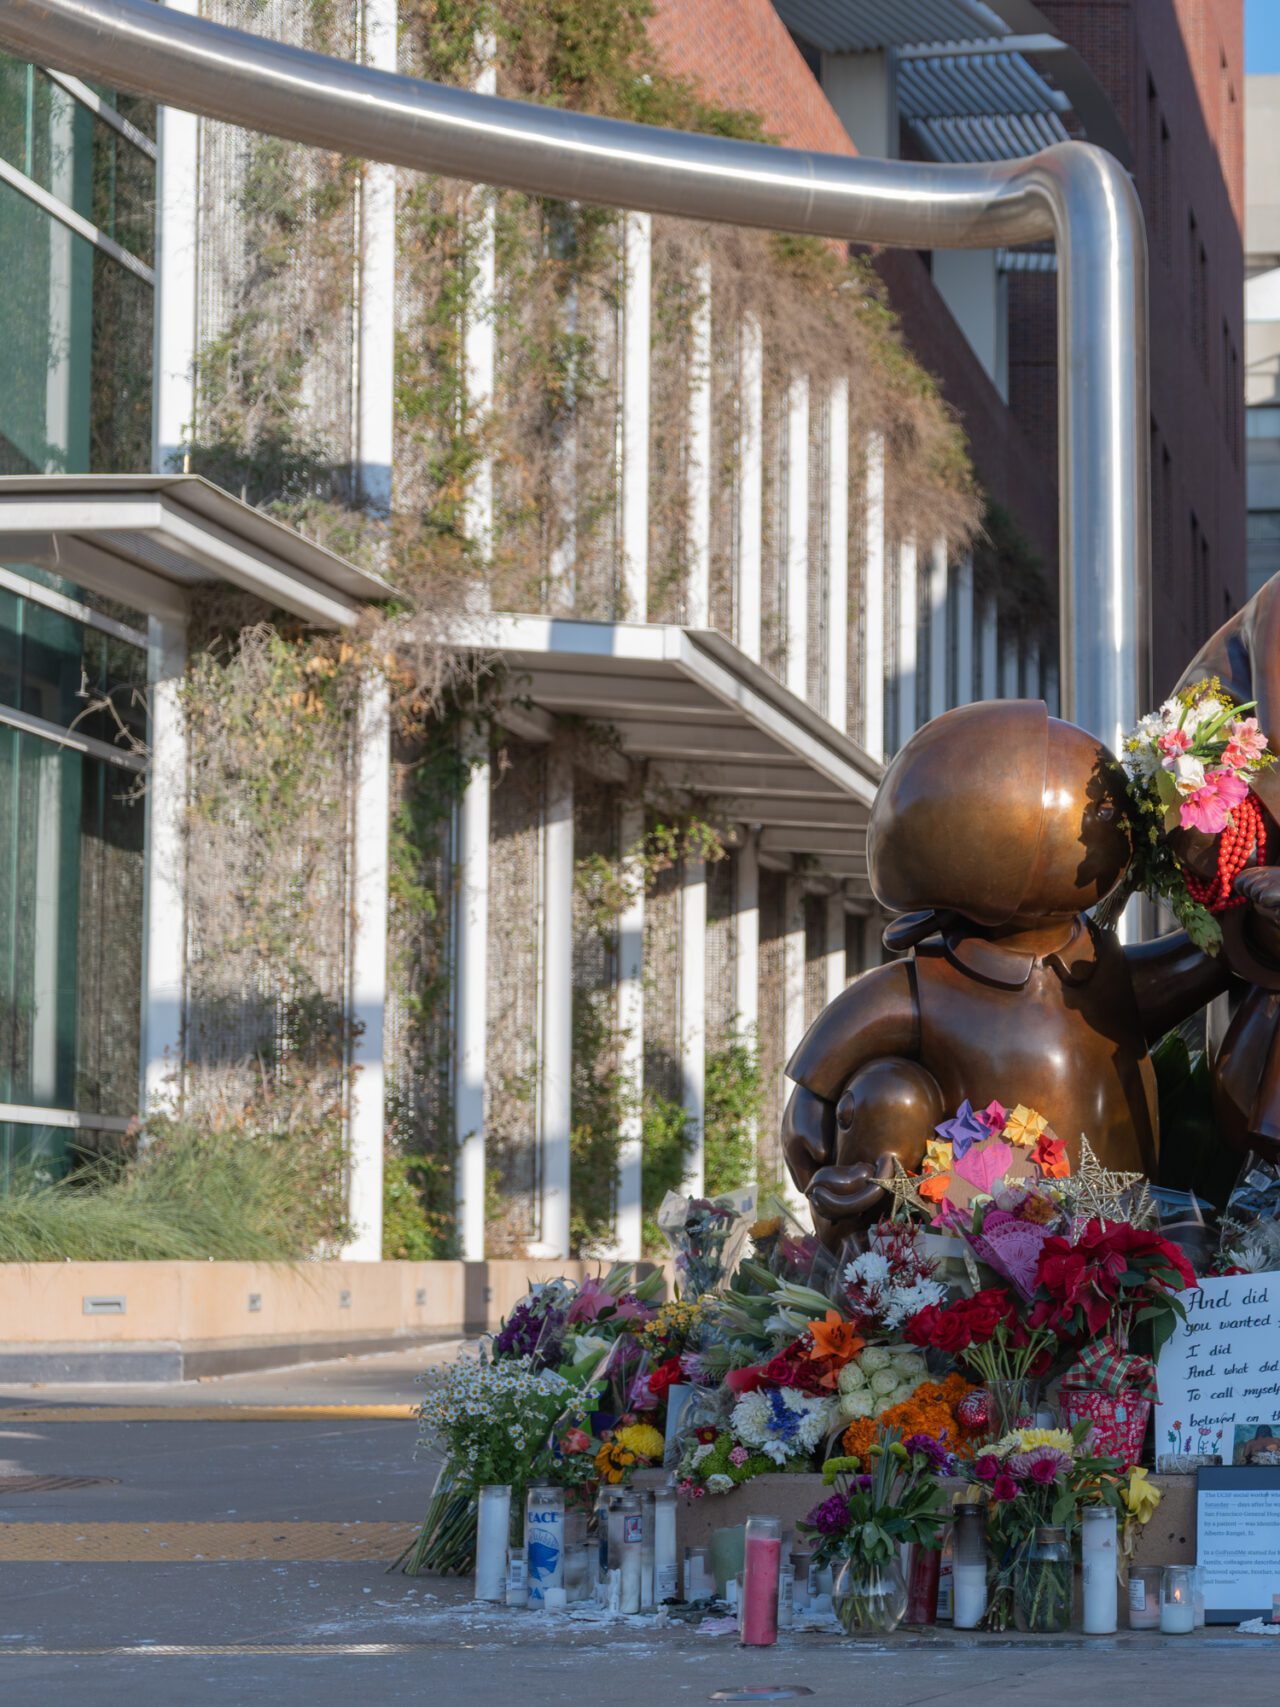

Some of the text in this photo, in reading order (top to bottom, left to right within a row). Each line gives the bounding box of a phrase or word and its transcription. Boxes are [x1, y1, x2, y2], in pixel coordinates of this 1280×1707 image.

[1187, 1288, 1230, 1312] And
[1242, 1288, 1268, 1304] did
[1183, 1322, 1211, 1337] you
[1220, 1316, 1271, 1329] wanted
[1186, 1344, 1232, 1359] I did
[1184, 1366, 1215, 1380] And
[1224, 1364, 1248, 1375] what
[1259, 1360, 1279, 1372] did
[1187, 1389, 1201, 1401] To
[1210, 1387, 1233, 1399] call
[1190, 1412, 1236, 1427] beloved
[1246, 1414, 1259, 1422] on
[528, 1512, 559, 1523] EACE
[528, 1586, 550, 1600] PA
